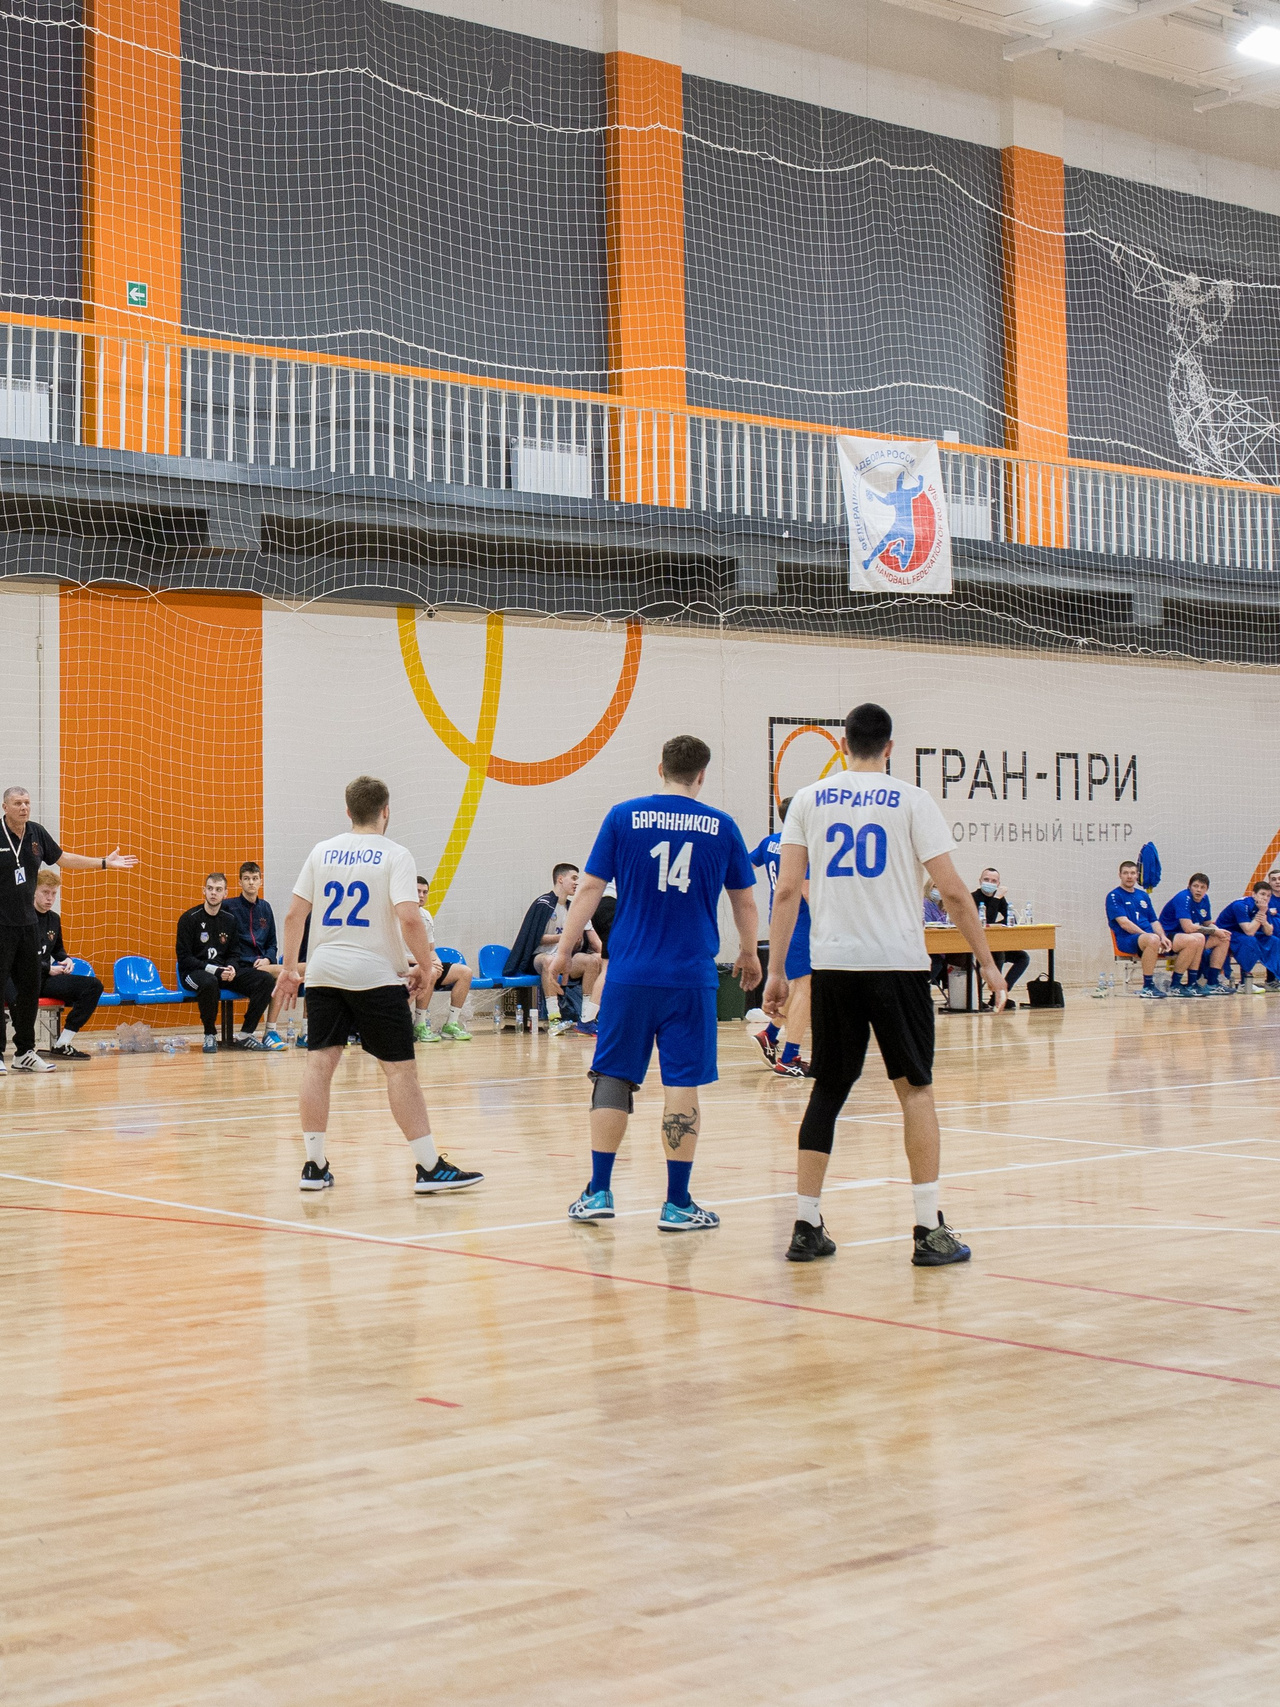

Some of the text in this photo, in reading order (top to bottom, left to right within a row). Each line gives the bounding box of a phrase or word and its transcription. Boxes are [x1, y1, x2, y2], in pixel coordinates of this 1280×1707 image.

[875, 563, 911, 585] HANDBALL
[911, 538, 943, 583] FEDERATION
[915, 747, 1138, 802] ГРАН-ПРИ
[631, 810, 720, 836] БАРАННИКОВ
[952, 818, 1133, 846] ОРТИВНЫЙ ЦЕНТР
[323, 849, 383, 866] ГРИБКОВ
[649, 841, 694, 894] 14
[825, 822, 888, 879] 20
[322, 880, 370, 928] 22
[504, 1004, 516, 1012] LOU
